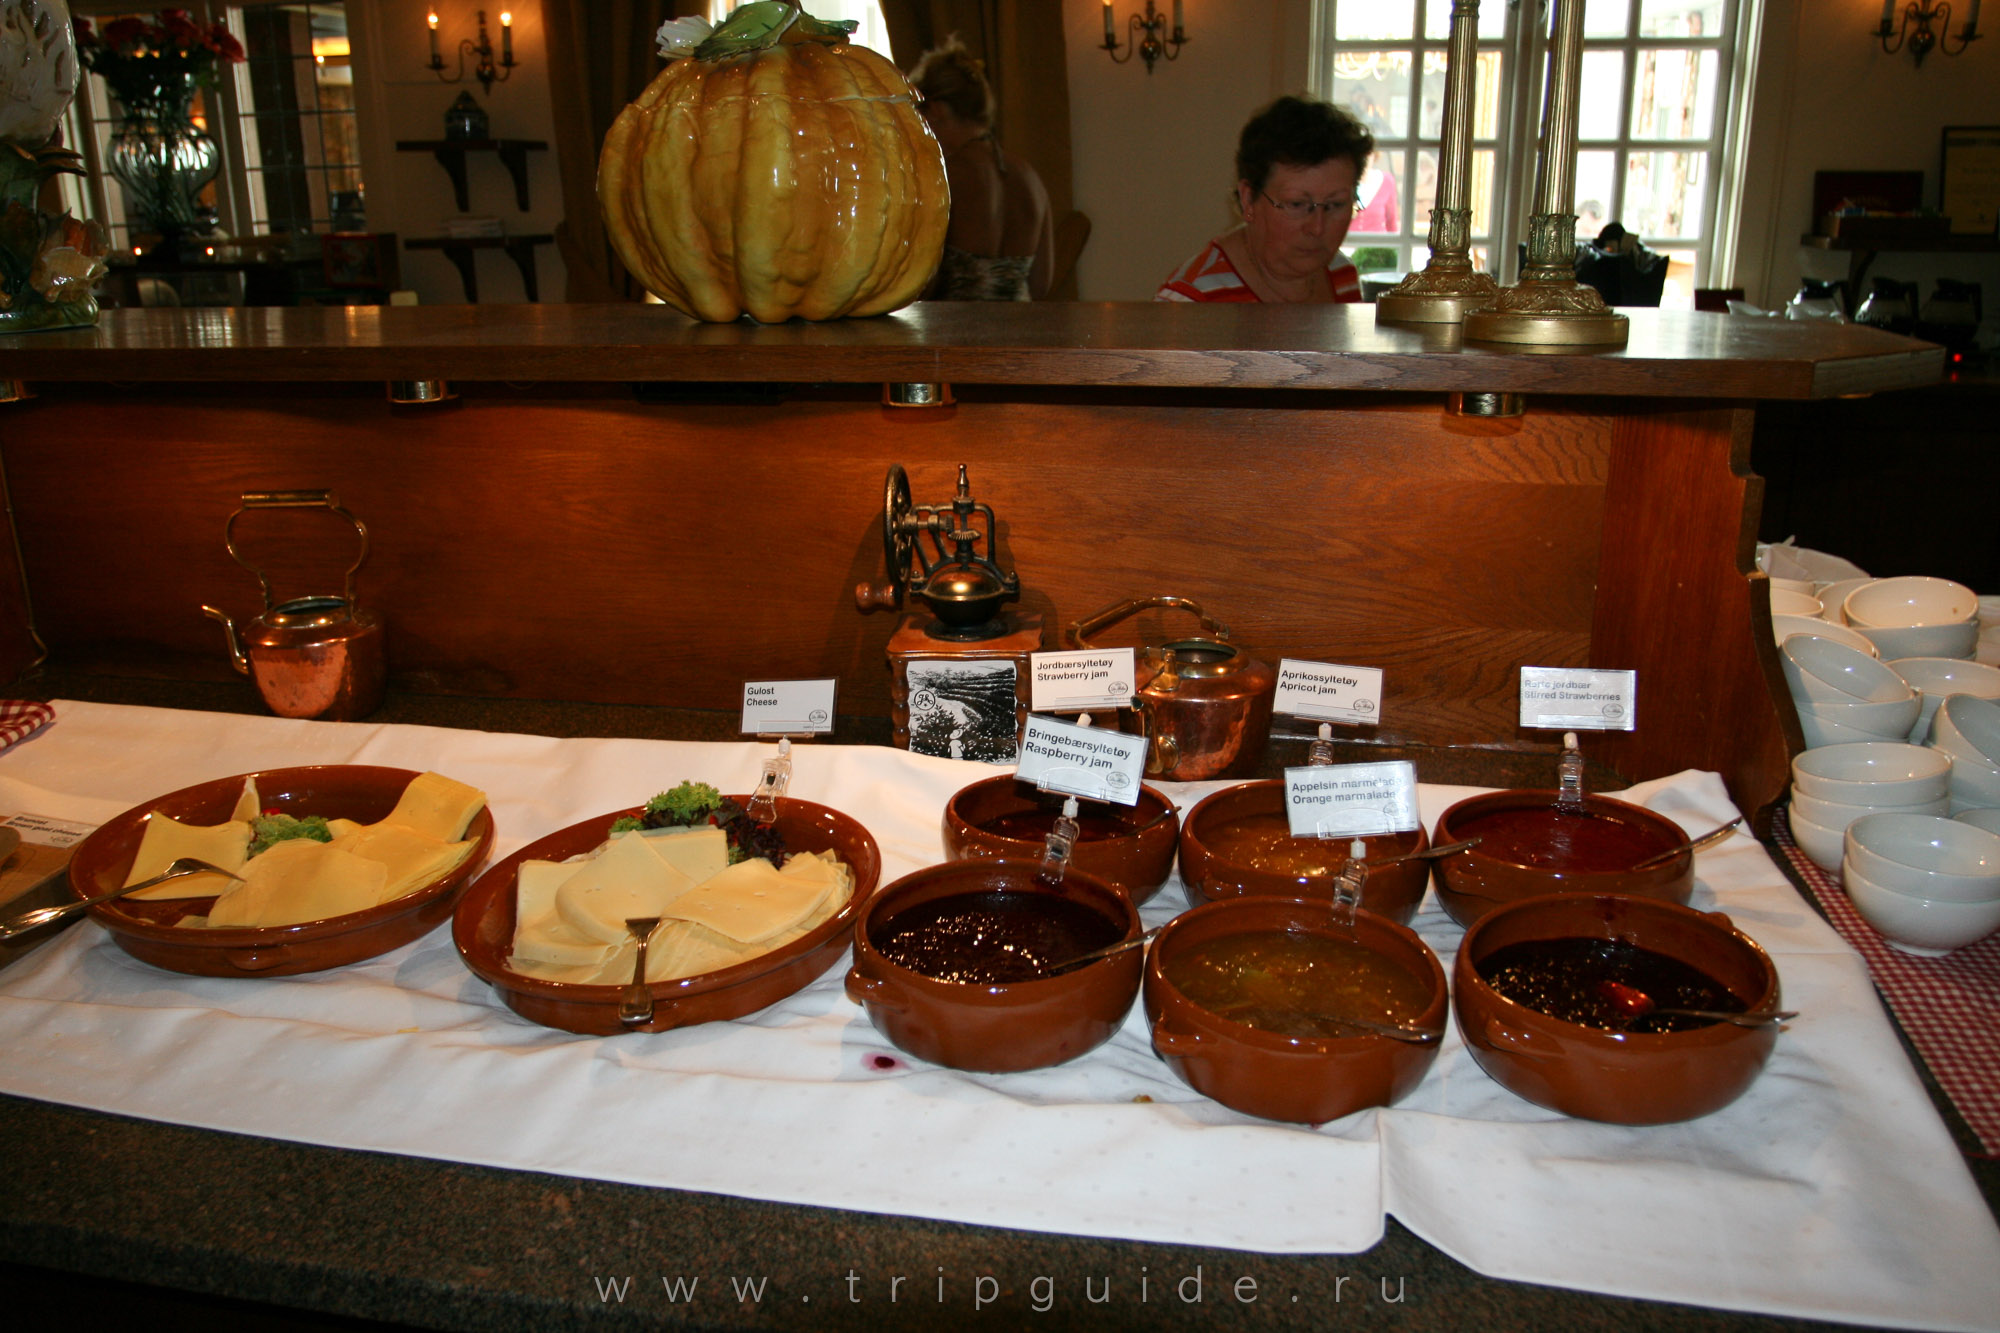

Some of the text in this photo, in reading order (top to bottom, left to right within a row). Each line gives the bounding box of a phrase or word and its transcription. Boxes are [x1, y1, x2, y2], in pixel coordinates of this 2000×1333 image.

[1037, 658, 1113, 670] Jordbærsyltetøy
[1037, 670, 1109, 681] Strawberry jam
[1281, 670, 1358, 687] Aprikossyltetøy
[747, 687, 775, 695] Gulost
[1280, 681, 1337, 695] Apricot jam
[1552, 680, 1591, 690] jordbær
[746, 698, 778, 706] Cheese
[1524, 692, 1621, 701] Stirred Strawberries
[1028, 728, 1131, 760] Bringebærsyltetøy
[1025, 742, 1113, 769] Raspberry jam
[1292, 781, 1338, 793] Appelsin
[1293, 790, 1396, 805] Orange marmalade
